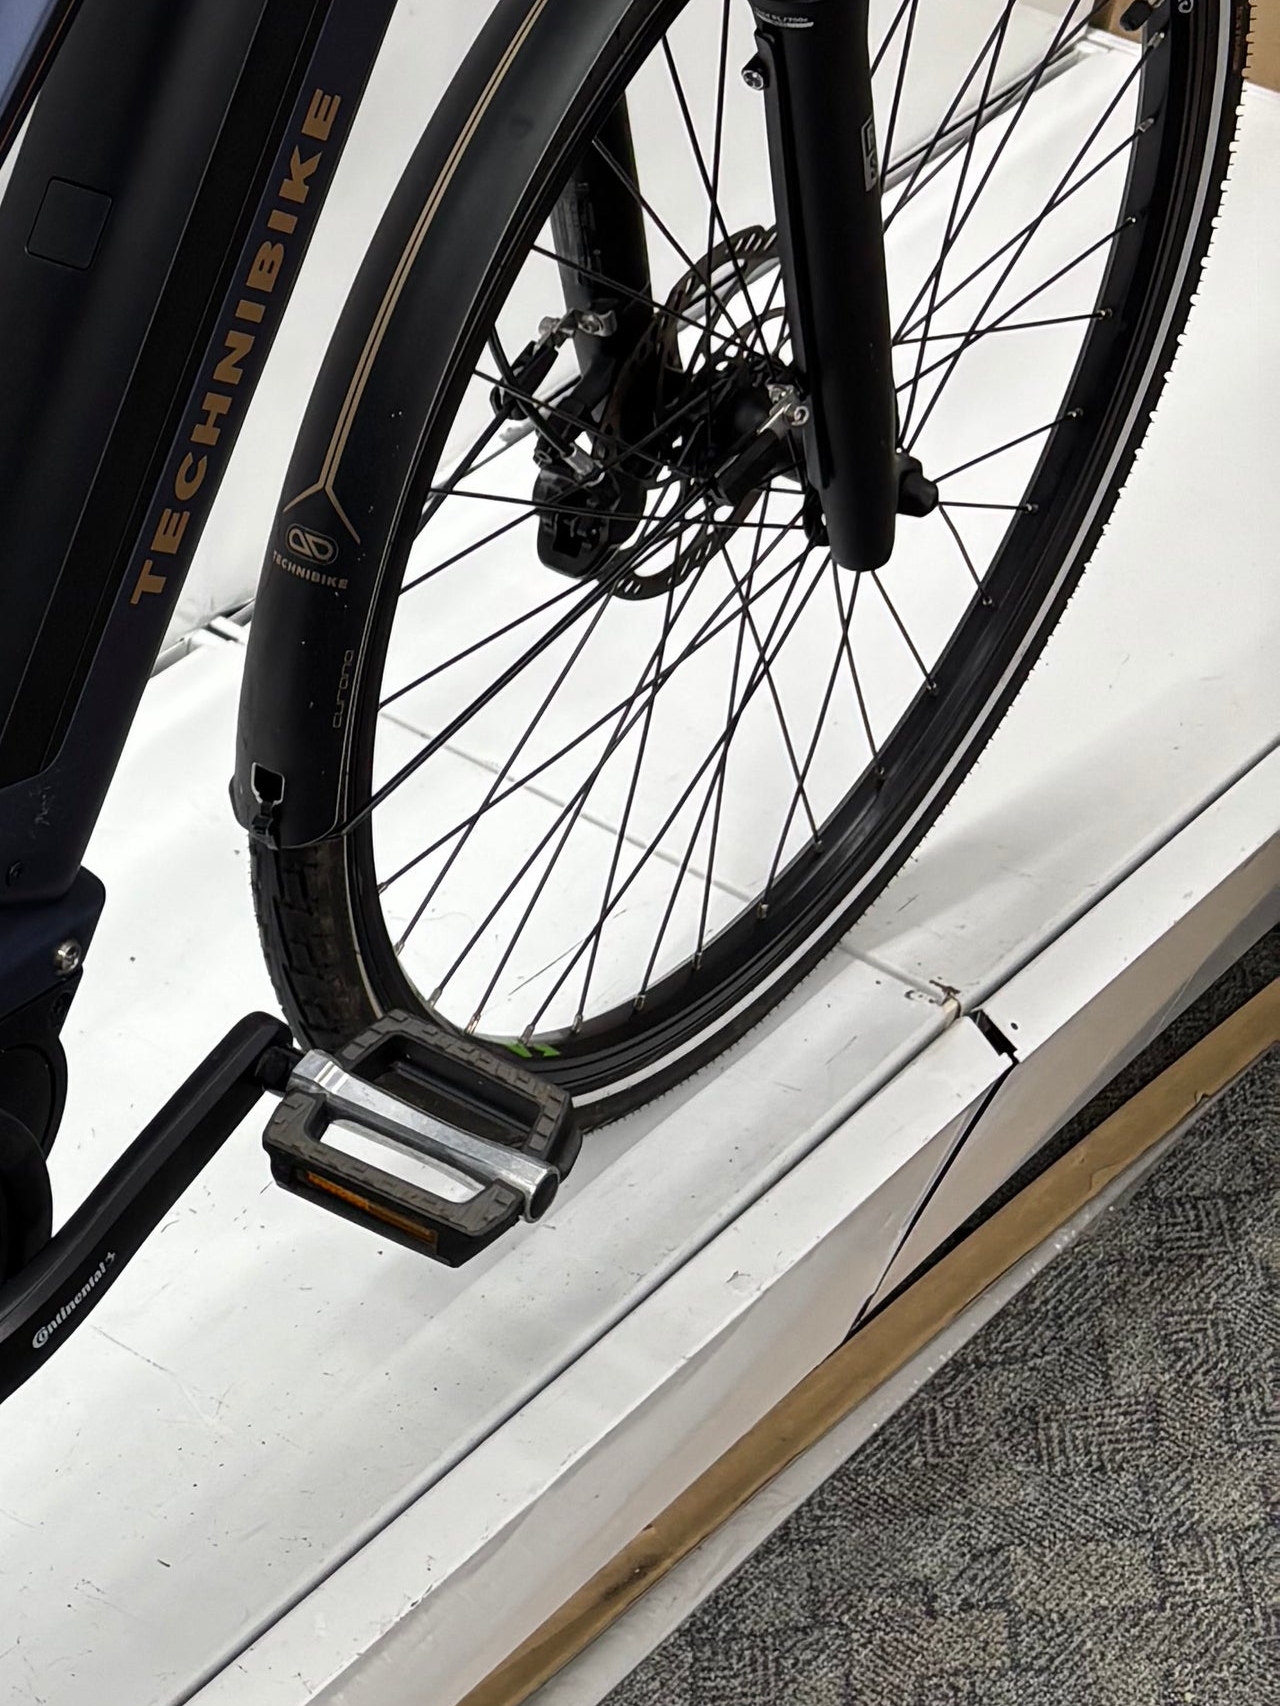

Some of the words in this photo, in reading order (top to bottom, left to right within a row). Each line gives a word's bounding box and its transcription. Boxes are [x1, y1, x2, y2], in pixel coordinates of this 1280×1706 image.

[130, 89, 341, 605] TECHNIBIKE
[272, 549, 349, 590] TECHNIBIKE
[332, 649, 355, 729] curana
[32, 1261, 107, 1349] Continental
